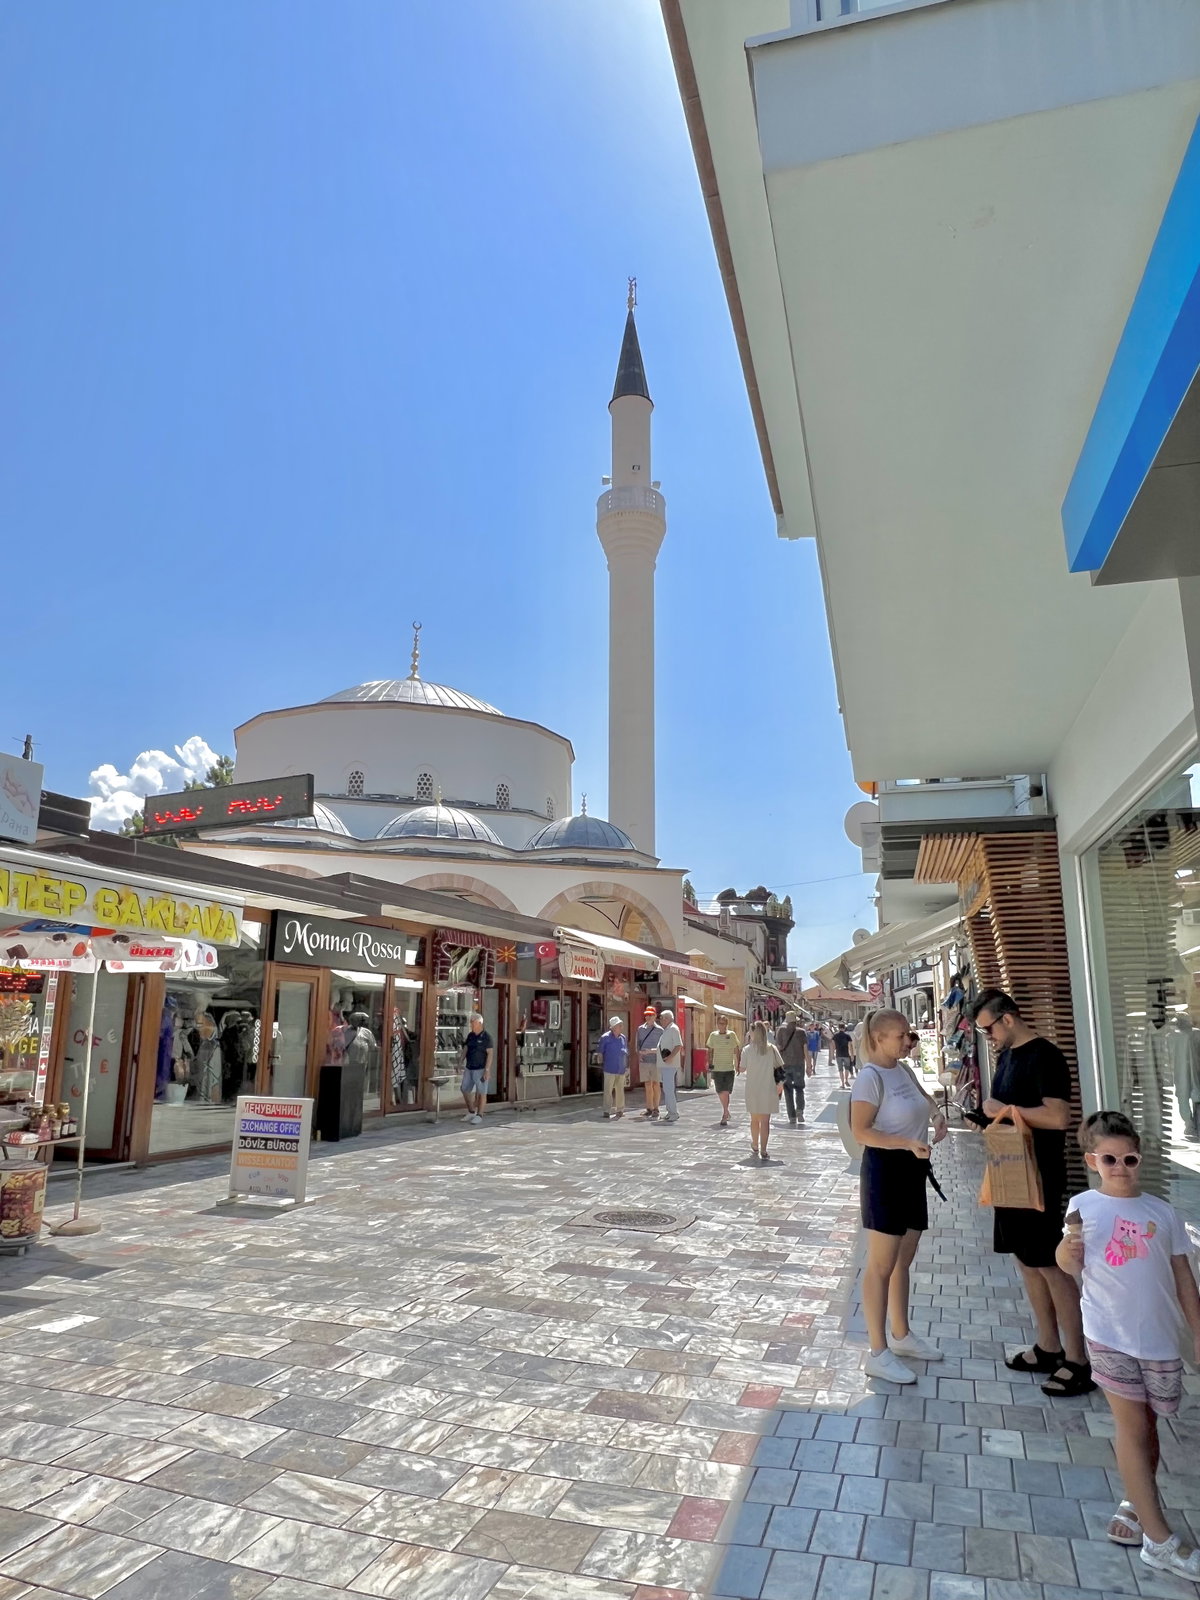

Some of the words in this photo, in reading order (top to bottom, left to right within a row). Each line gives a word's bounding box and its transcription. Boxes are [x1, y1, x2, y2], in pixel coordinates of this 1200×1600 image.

[1, 811, 29, 836] рана
[97, 887, 239, 942] BAKLAVA
[129, 943, 175, 958] ÜLKER
[283, 920, 350, 957] Monna
[352, 931, 401, 968] Rossa
[241, 1120, 278, 1133] EXCHANGE
